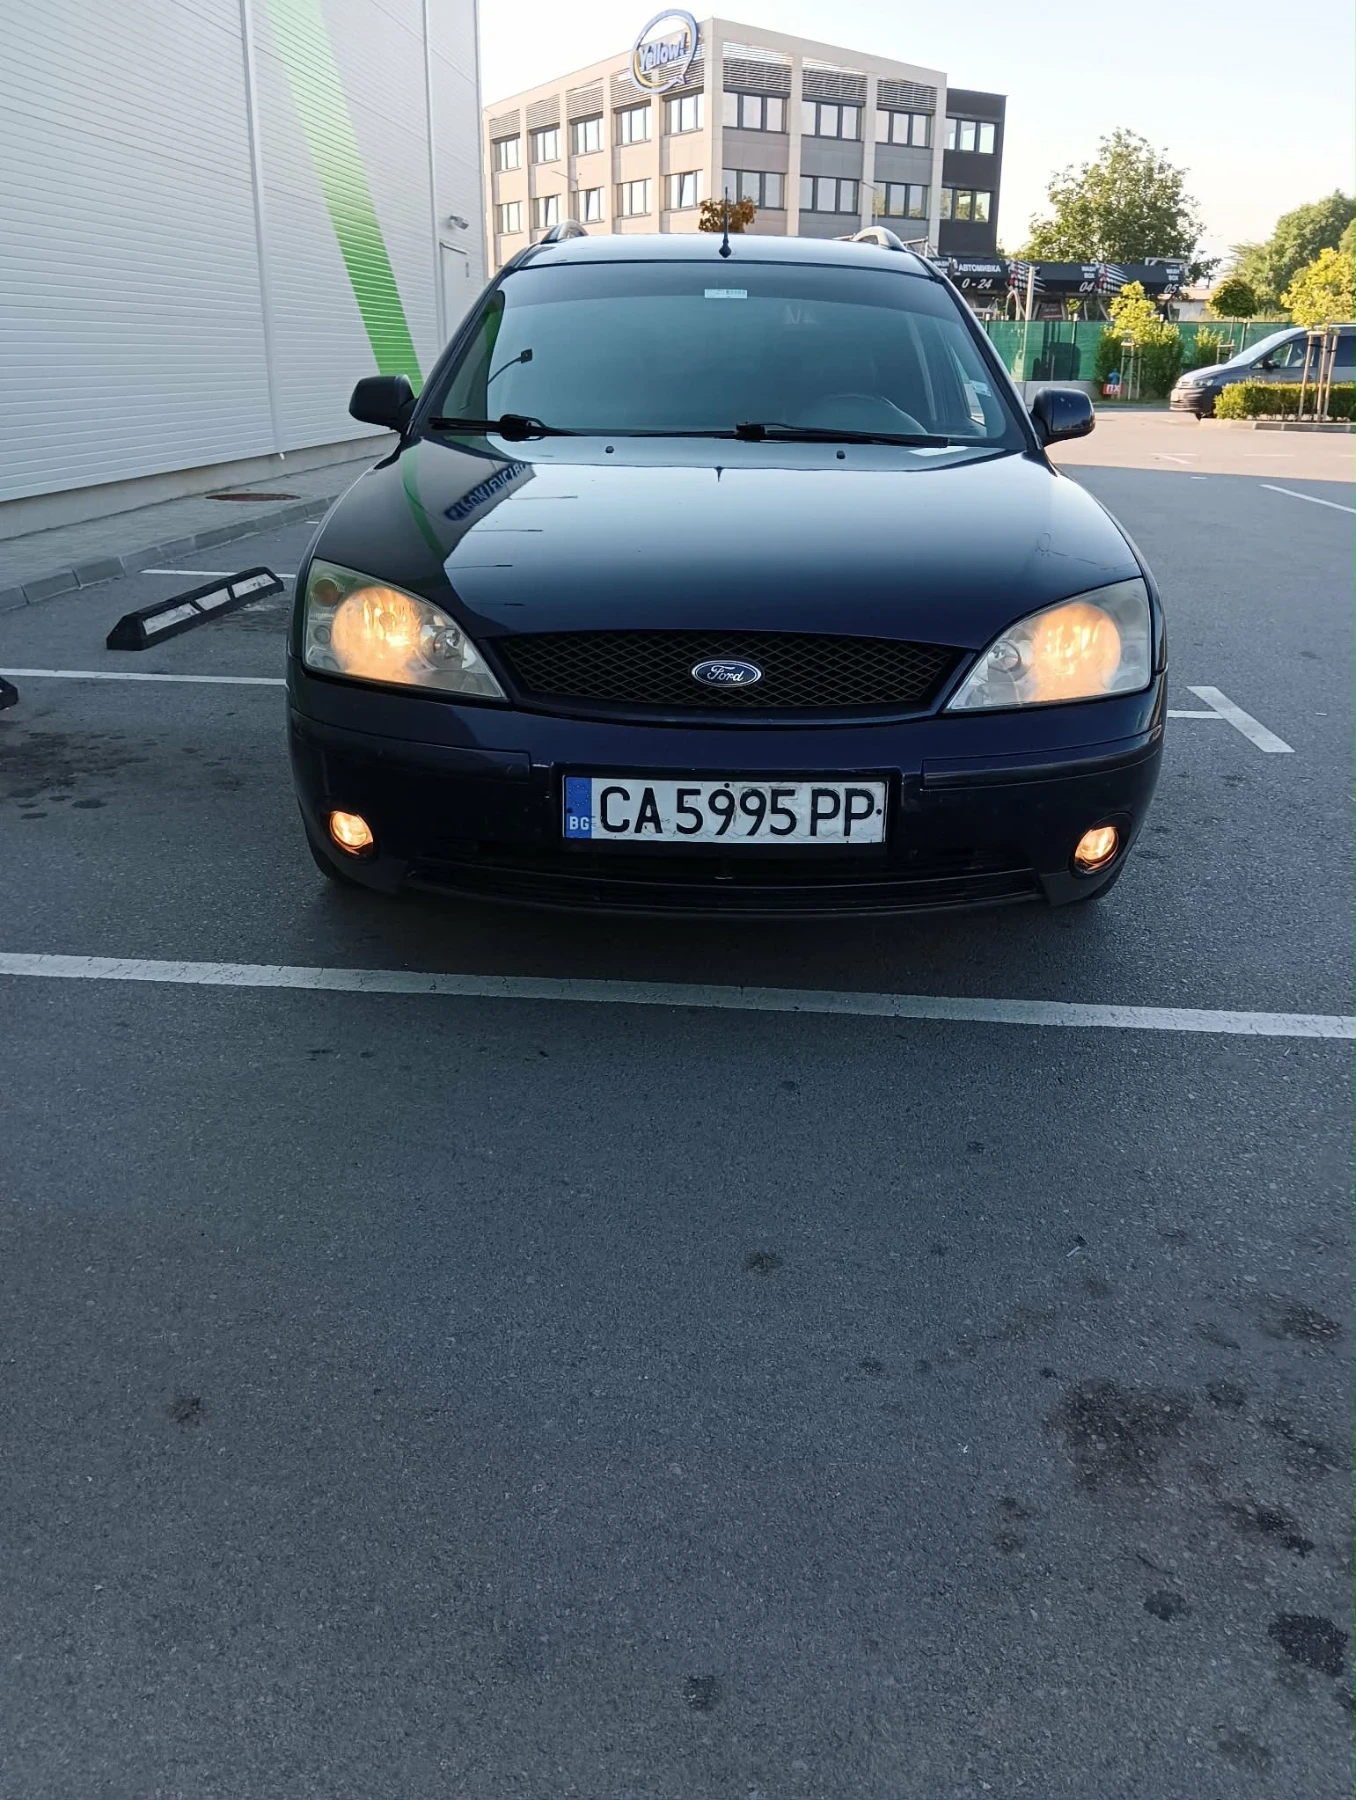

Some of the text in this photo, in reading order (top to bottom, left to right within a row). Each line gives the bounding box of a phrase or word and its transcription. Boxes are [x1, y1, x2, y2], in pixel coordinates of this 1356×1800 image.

[640, 32, 688, 71] Yellow!
[958, 264, 1001, 272] АВТОМИВКА
[977, 278, 993, 289] 24
[1079, 281, 1095, 292] 04
[1163, 283, 1179, 294] 05
[707, 664, 745, 682] Ford
[600, 786, 875, 837] CA 5995 PP
[569, 816, 590, 831] BG
